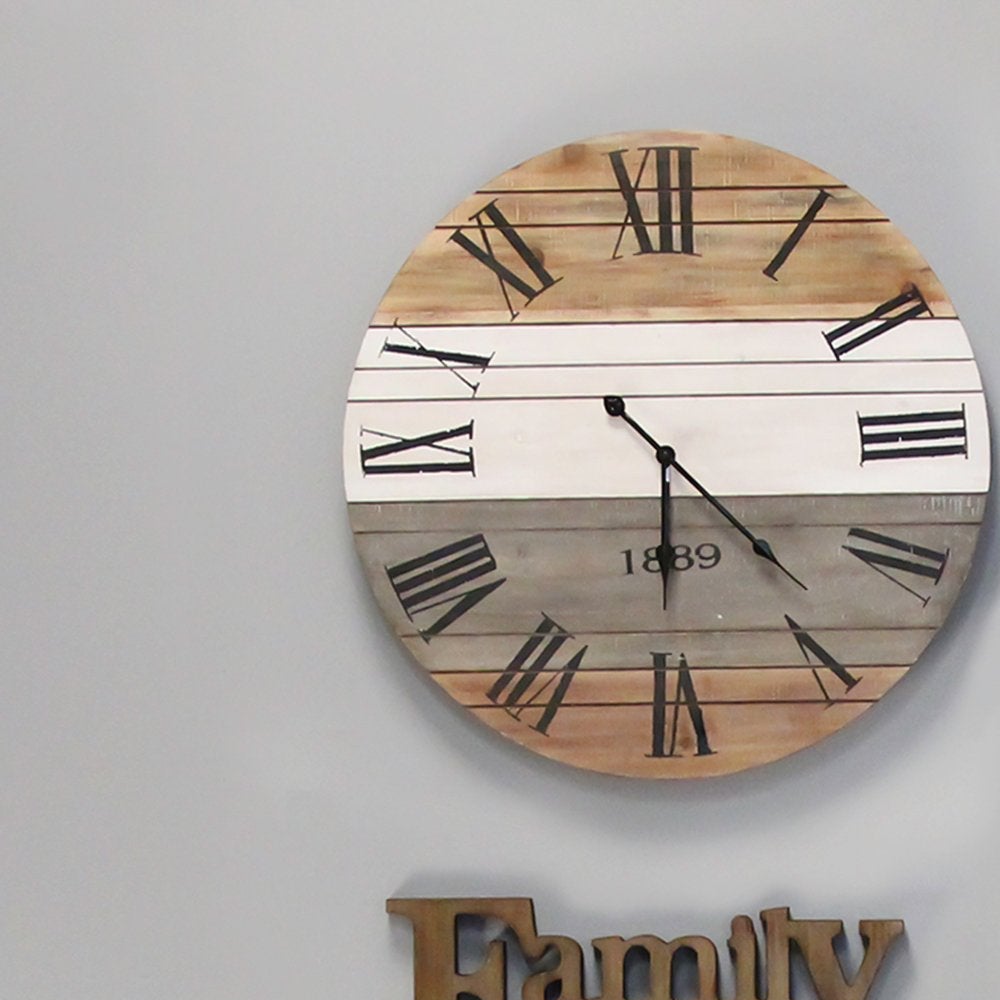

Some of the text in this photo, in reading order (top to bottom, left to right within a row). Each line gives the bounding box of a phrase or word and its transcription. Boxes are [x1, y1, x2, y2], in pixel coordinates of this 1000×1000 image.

[607, 146, 702, 260] XII
[763, 189, 834, 280] I
[447, 198, 563, 320] XI
[379, 319, 495, 398] X
[822, 284, 934, 360] II
[360, 419, 475, 477] IX
[856, 403, 967, 466] III
[384, 533, 507, 644] VIII
[620, 543, 721, 575] 1889
[842, 527, 949, 606] IV
[486, 611, 588, 737] VII
[645, 651, 716, 757] VI
[785, 614, 864, 707] V
